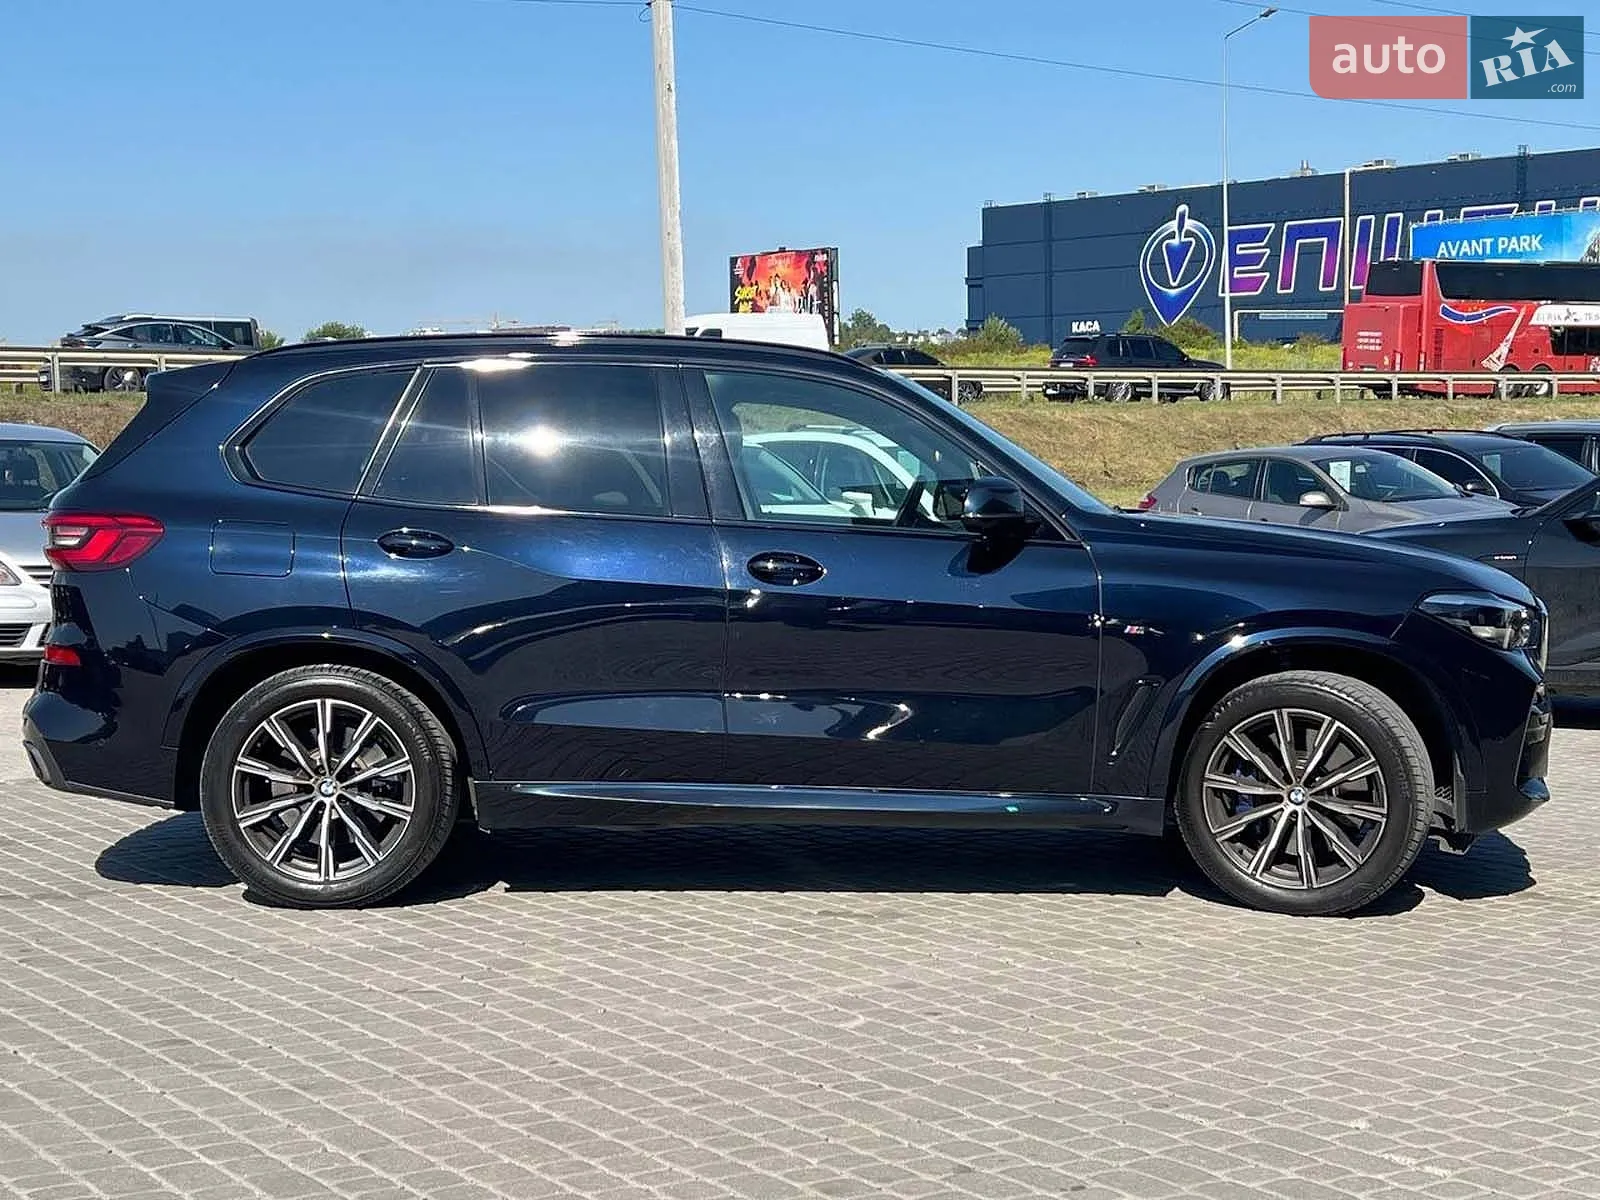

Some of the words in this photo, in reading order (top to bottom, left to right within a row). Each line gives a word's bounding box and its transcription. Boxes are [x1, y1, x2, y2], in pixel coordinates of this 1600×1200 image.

[1437, 238, 1495, 258] AVANT
[1498, 234, 1543, 254] PARK
[1071, 319, 1101, 334] КАСА
